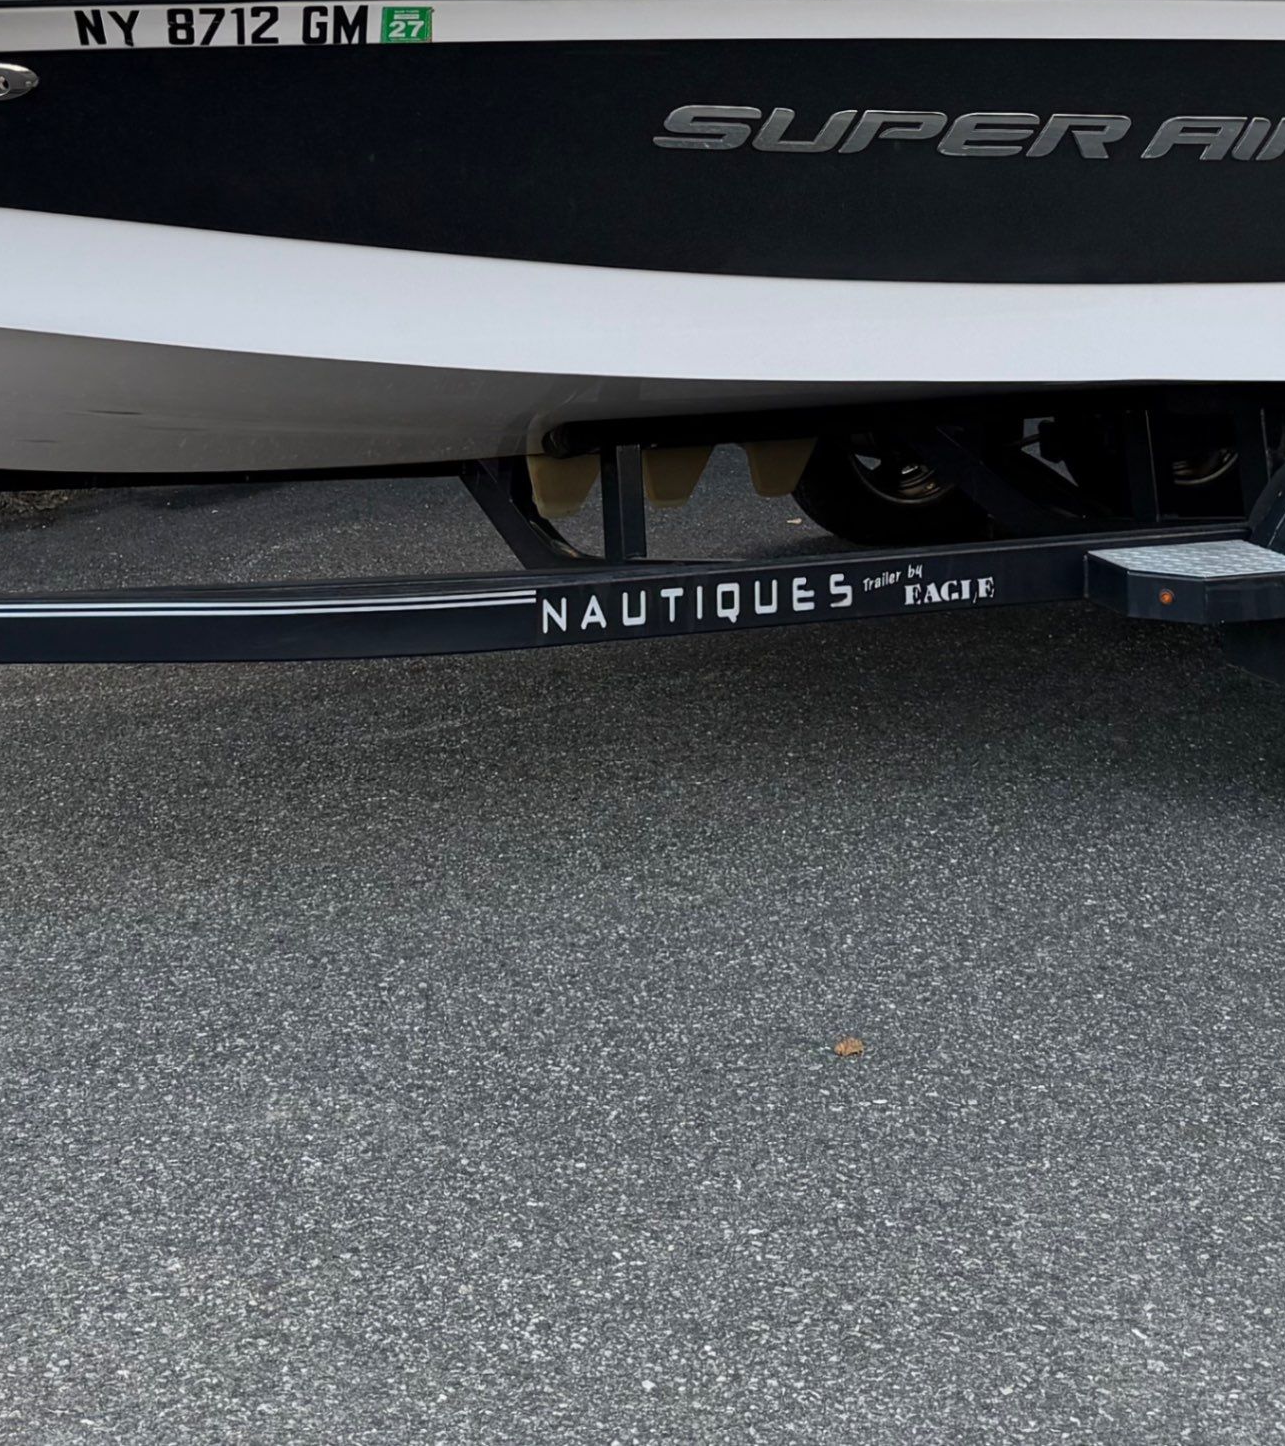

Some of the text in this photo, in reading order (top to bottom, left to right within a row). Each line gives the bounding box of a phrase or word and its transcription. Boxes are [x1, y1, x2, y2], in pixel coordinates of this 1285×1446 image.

[74, 5, 369, 48] NY 8712 GM
[388, 20, 425, 38] 27
[653, 104, 1132, 159] SUPER
[862, 564, 923, 592] Trailer by
[903, 576, 995, 606] EAGLE
[542, 573, 853, 634] NAUTIQUES
